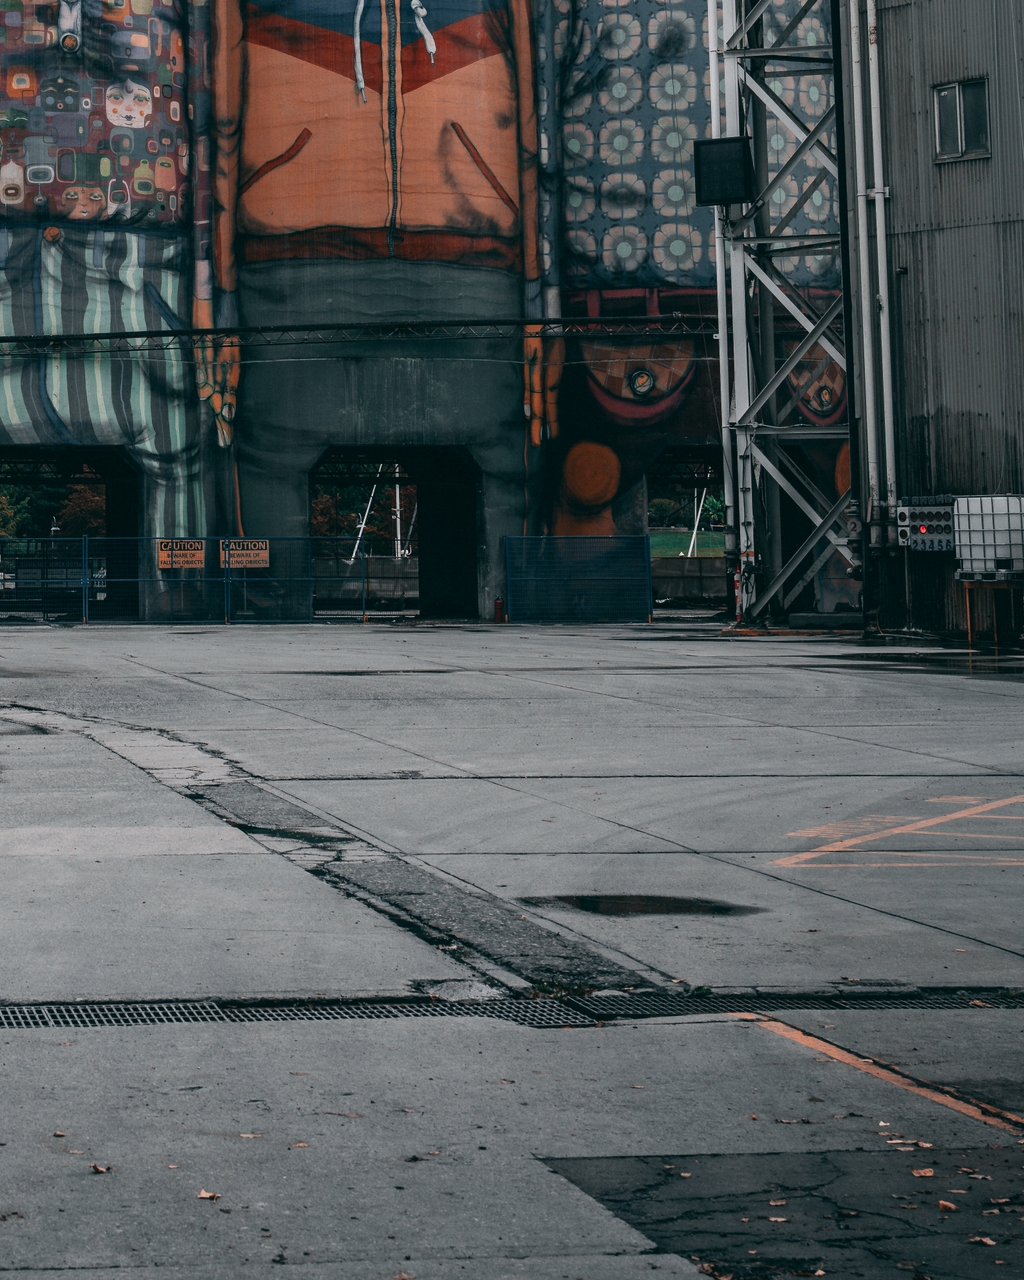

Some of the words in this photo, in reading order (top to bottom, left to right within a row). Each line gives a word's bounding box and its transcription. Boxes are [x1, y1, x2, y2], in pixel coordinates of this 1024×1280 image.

[850, 522, 857, 532] 2
[913, 540, 918, 551] 2
[921, 540, 926, 551] 3
[929, 540, 935, 551] 4
[938, 540, 943, 551] 5
[946, 540, 952, 551] 6
